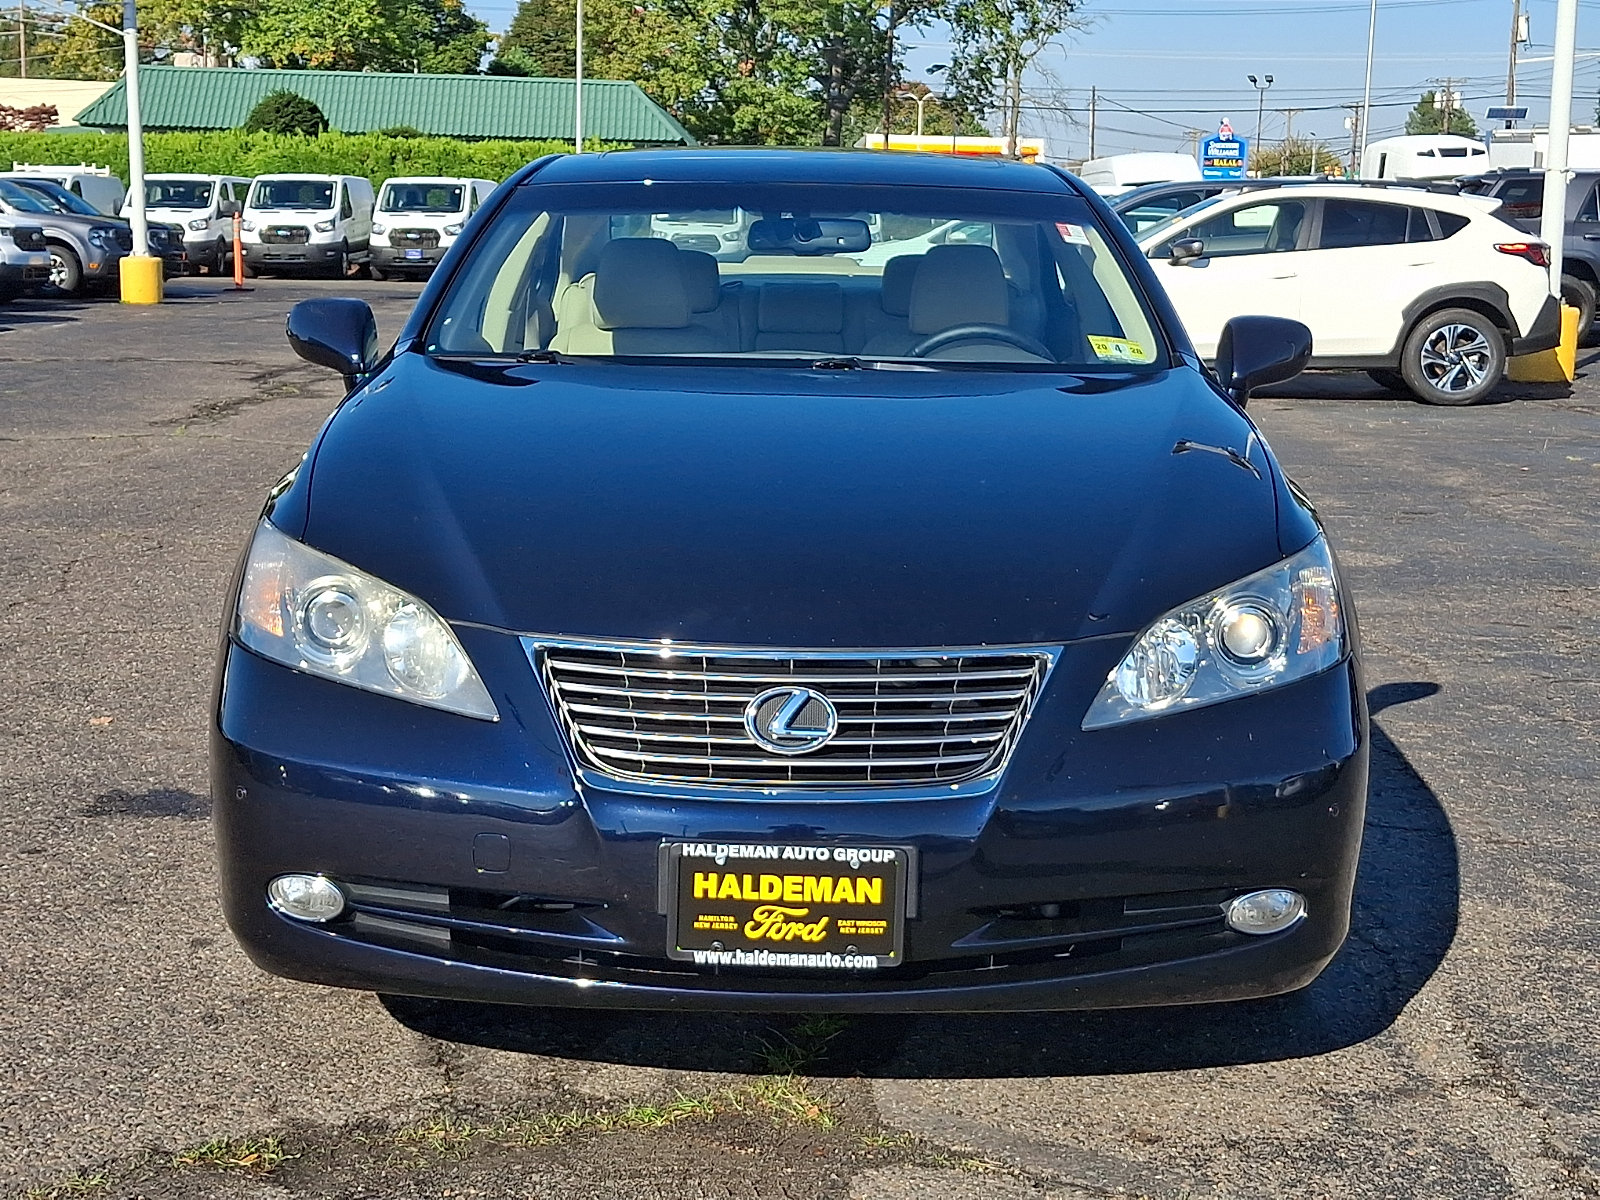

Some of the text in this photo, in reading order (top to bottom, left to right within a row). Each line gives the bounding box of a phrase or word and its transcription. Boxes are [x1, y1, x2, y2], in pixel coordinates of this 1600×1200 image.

[682, 843, 895, 863] HALDEMAN AUTO GROUP
[693, 872, 881, 904] HALDEMAN
[744, 905, 829, 942] Ford
[693, 950, 878, 969] www.haldemanauto.com
